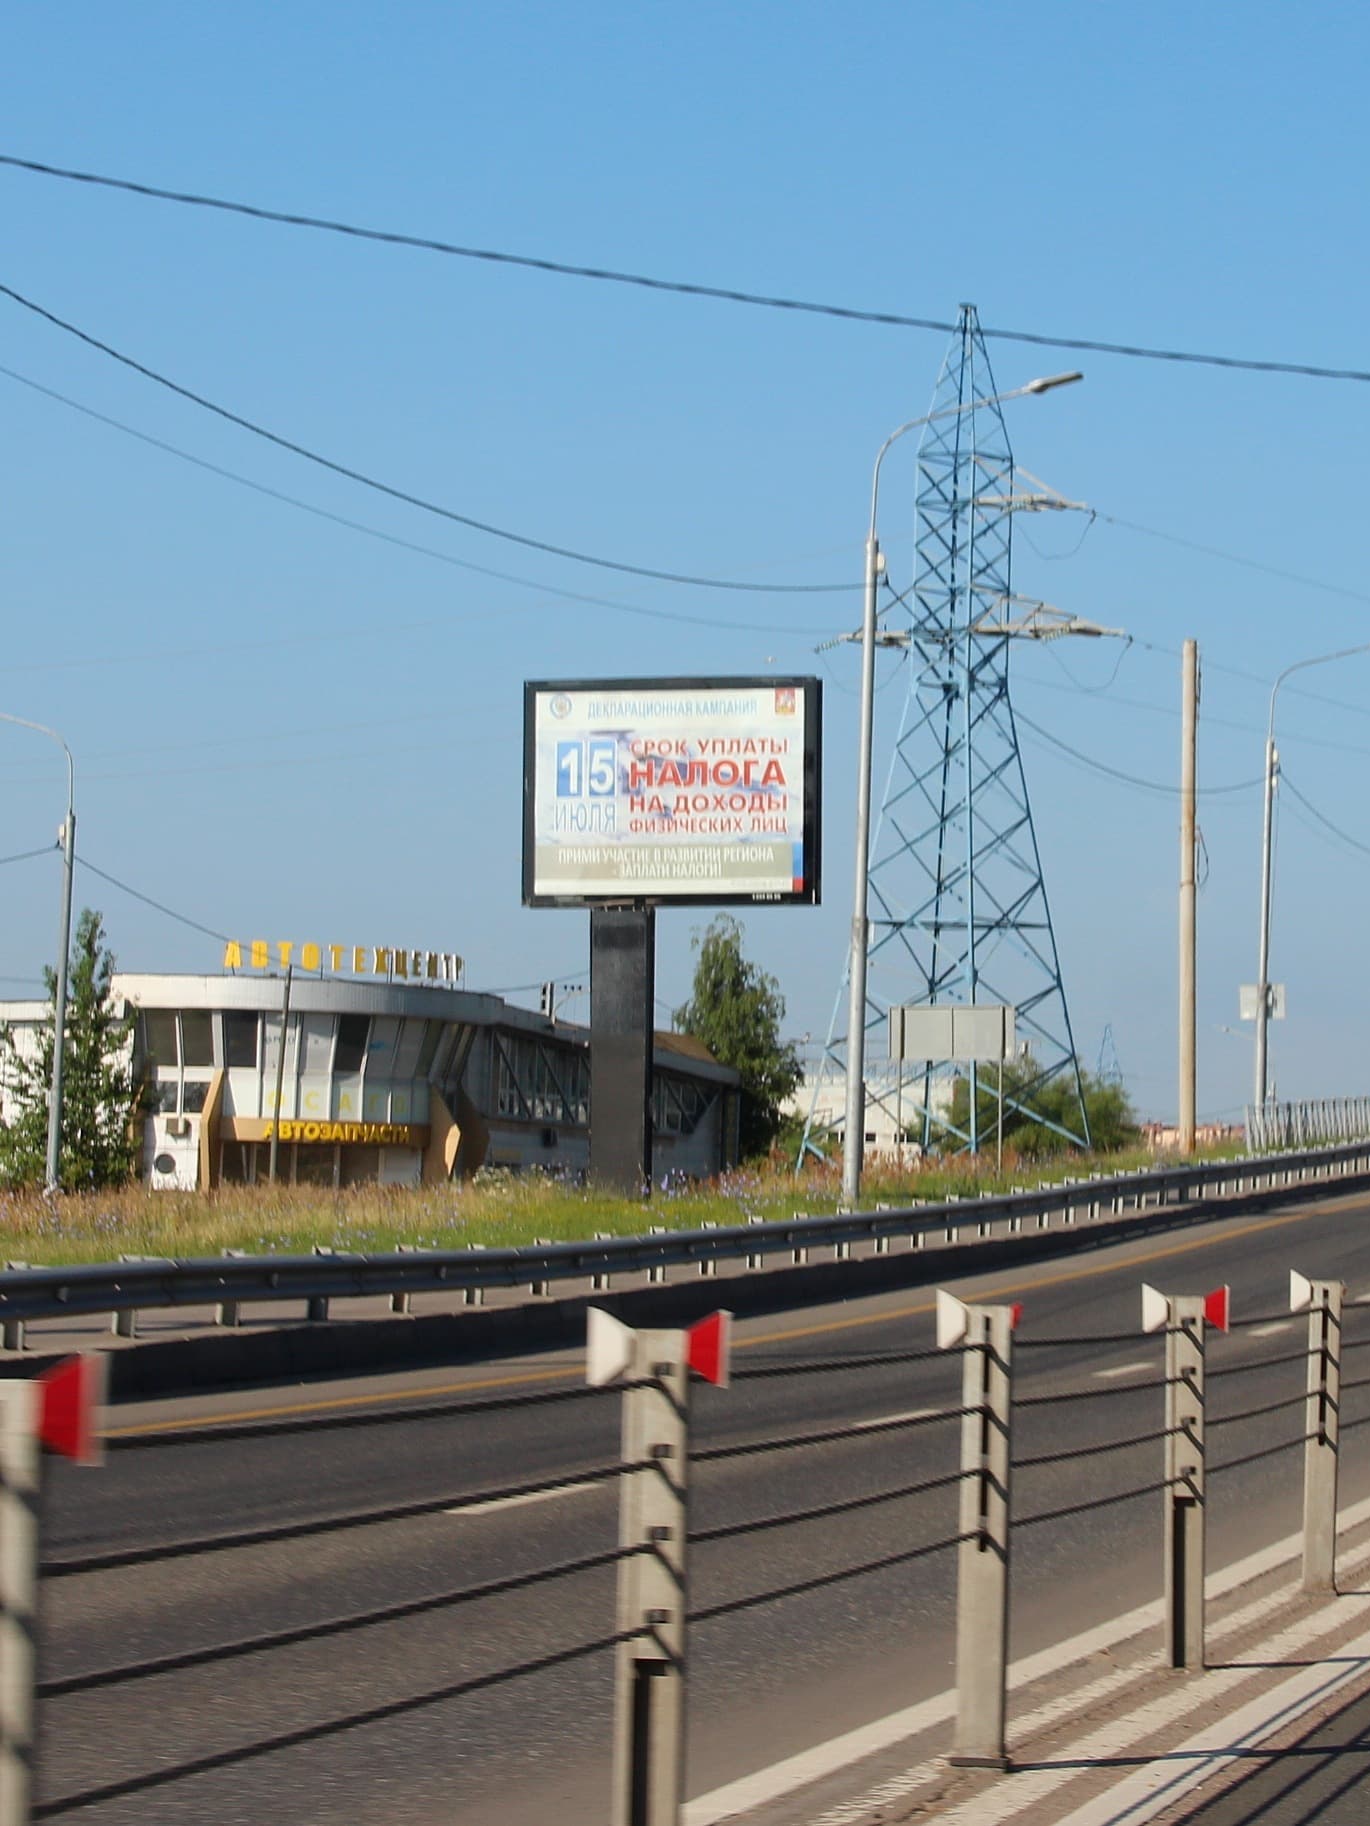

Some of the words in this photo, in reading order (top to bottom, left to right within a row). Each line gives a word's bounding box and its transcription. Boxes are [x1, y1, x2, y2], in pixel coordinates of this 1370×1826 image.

[587, 699, 693, 719] ДЕКЛАРАЦИОННАЯ
[695, 699, 758, 717] КАМПАНИЯ
[630, 739, 687, 756] СРОК
[697, 738, 788, 754] УПЛАТЫ
[560, 746, 614, 796] 15
[629, 759, 786, 788] НАЛОГА
[629, 795, 665, 813] НА
[672, 793, 787, 815] ДОХОДЫ
[554, 803, 616, 832] ИЮЛЯ
[629, 817, 744, 833] ФИЗИЧЕСКИХ
[750, 817, 788, 834] ЛИЦ
[558, 847, 600, 864] ПРИМИ
[723, 846, 775, 862] РЕГИОНА
[223, 940, 463, 982] АВТОТЕХЦЕНТР
[268, 1089, 408, 1114] ОСАГО
[263, 1120, 409, 1144] АВТОЗАПЧАСТИ
